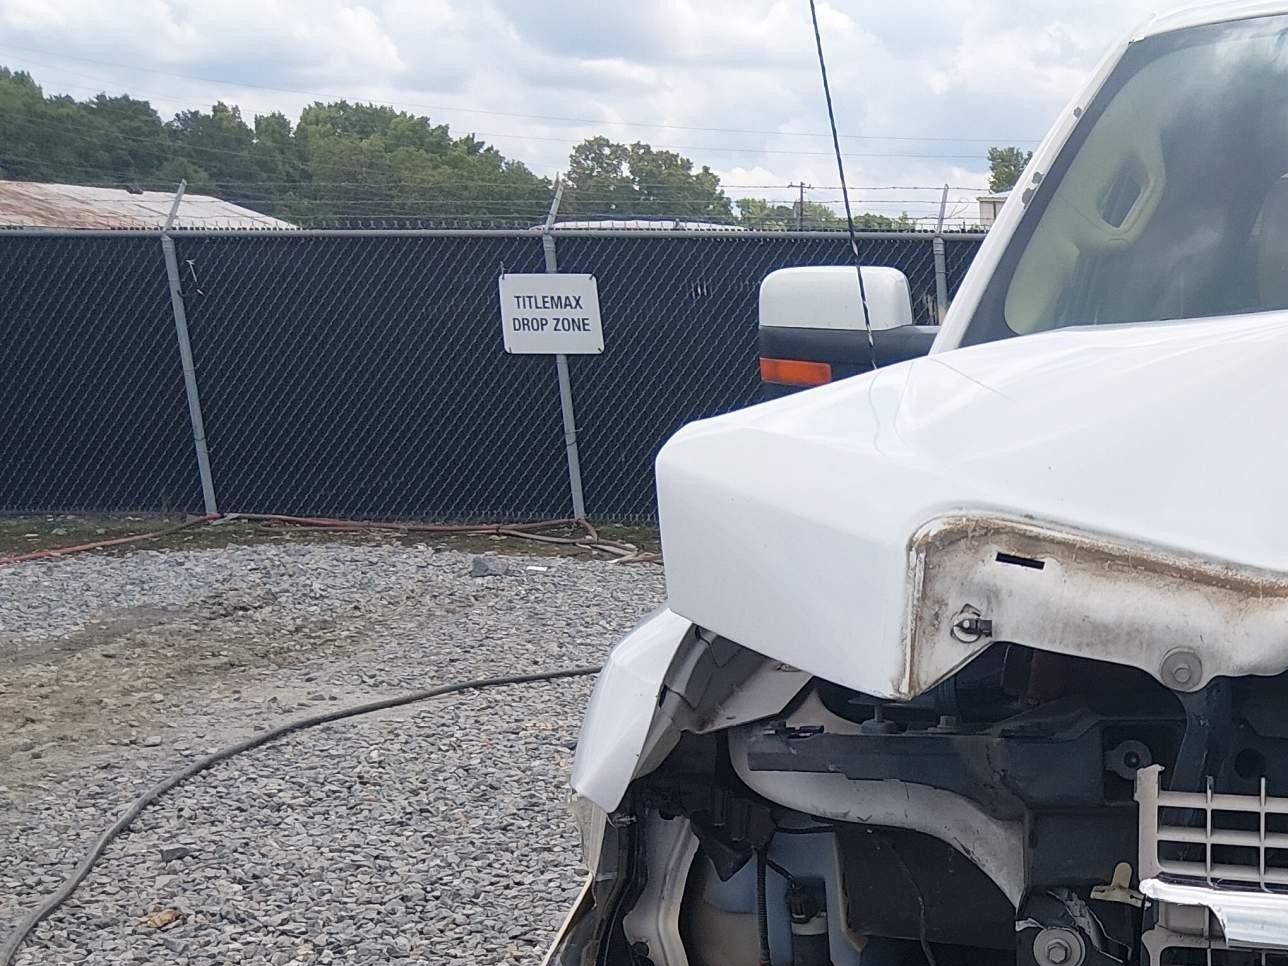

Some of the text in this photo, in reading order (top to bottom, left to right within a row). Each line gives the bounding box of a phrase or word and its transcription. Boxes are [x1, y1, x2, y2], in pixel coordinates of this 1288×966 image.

[514, 295, 583, 309] TITLEMAX
[513, 317, 591, 331] DROP ZONE
